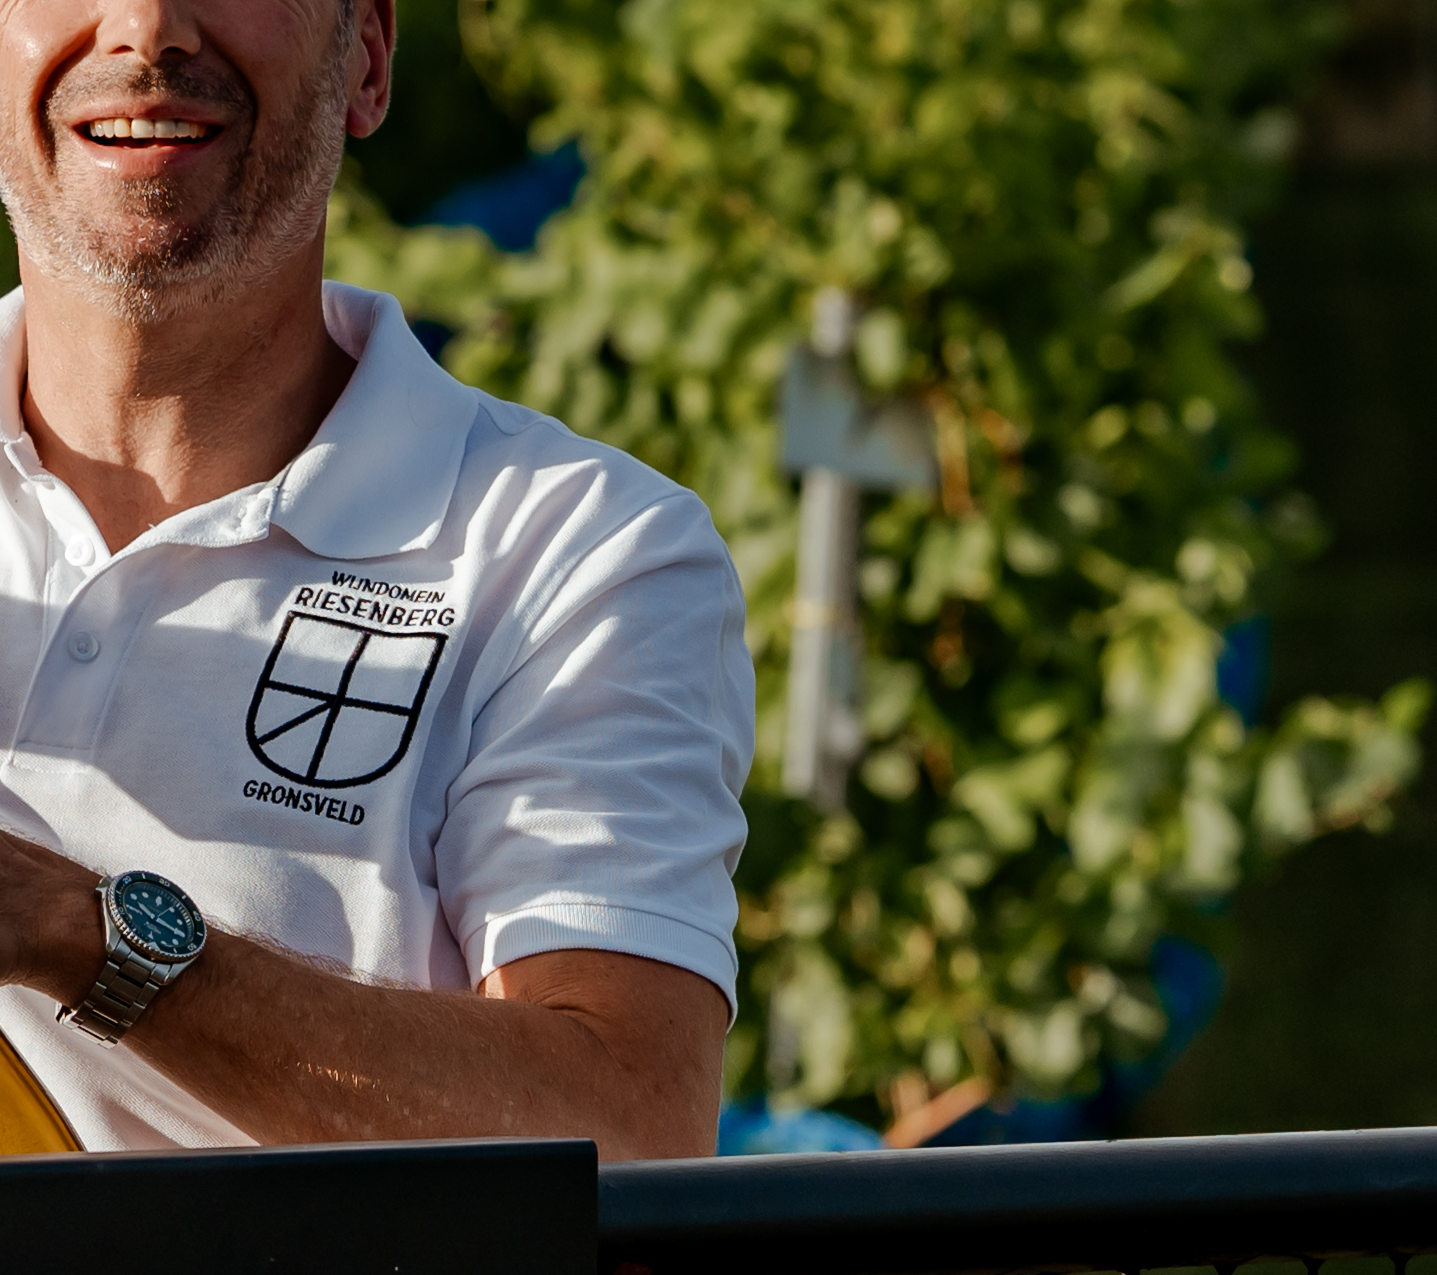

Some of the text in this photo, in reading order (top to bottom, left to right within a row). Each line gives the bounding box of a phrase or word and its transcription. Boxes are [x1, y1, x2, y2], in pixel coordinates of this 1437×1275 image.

[294, 587, 456, 627] RIESENBERG
[332, 570, 446, 604] WIJNDOMEIN
[243, 779, 365, 826] GRONSVELD
